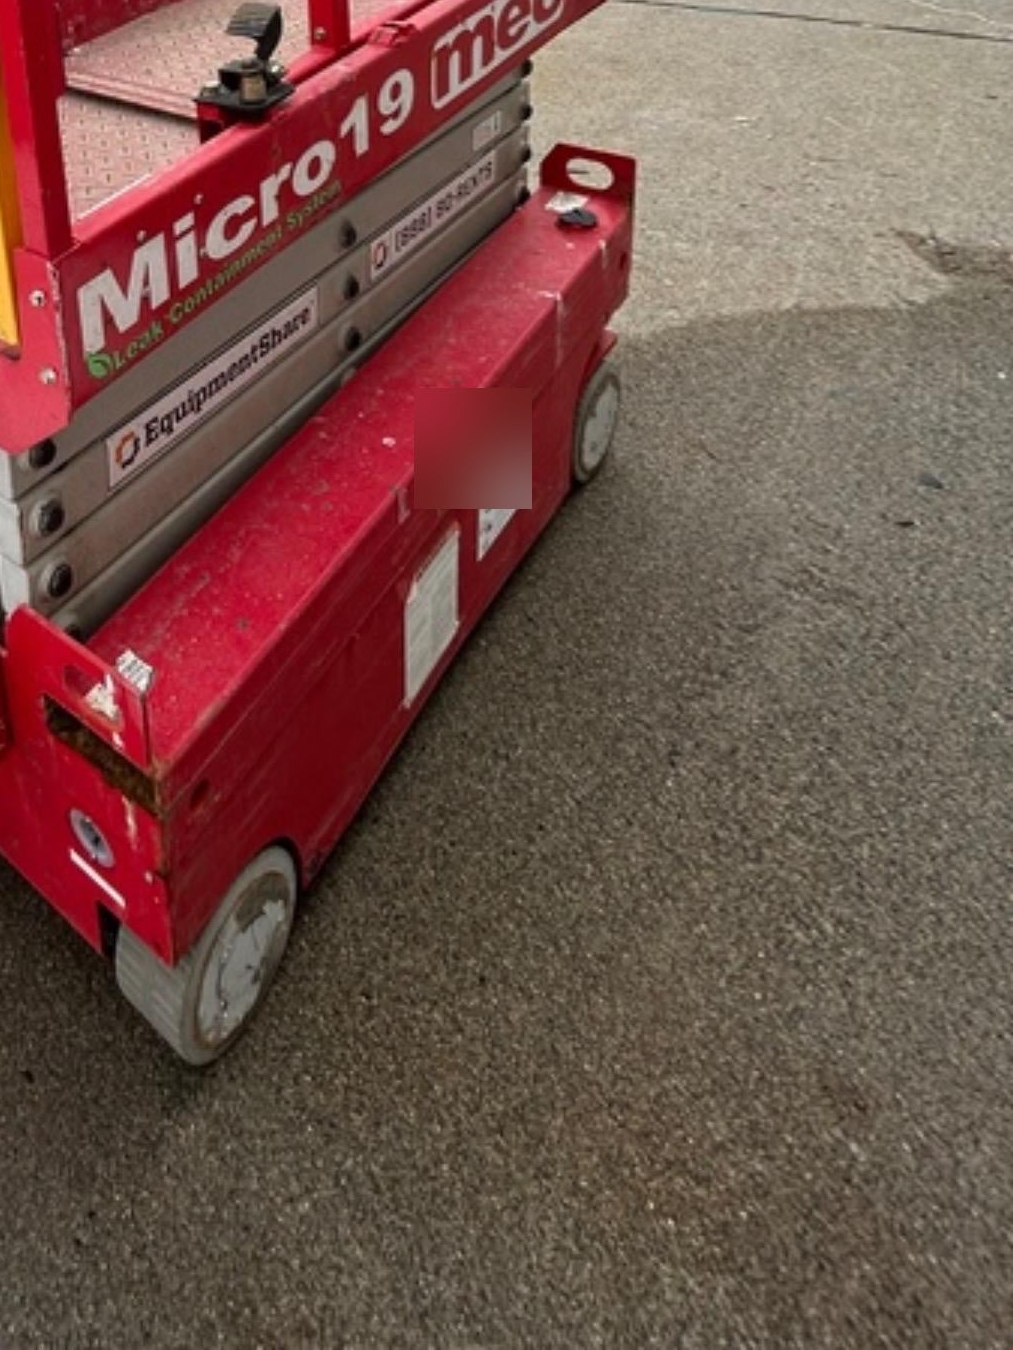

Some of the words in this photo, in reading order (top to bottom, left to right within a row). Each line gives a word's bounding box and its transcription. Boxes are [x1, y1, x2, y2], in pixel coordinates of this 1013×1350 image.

[77, 139, 337, 358] Micro
[339, 67, 415, 158] 19
[112, 320, 165, 371] Leak
[167, 225, 284, 324] Containment
[286, 179, 342, 229] System
[144, 306, 311, 448] EquipmentShare
